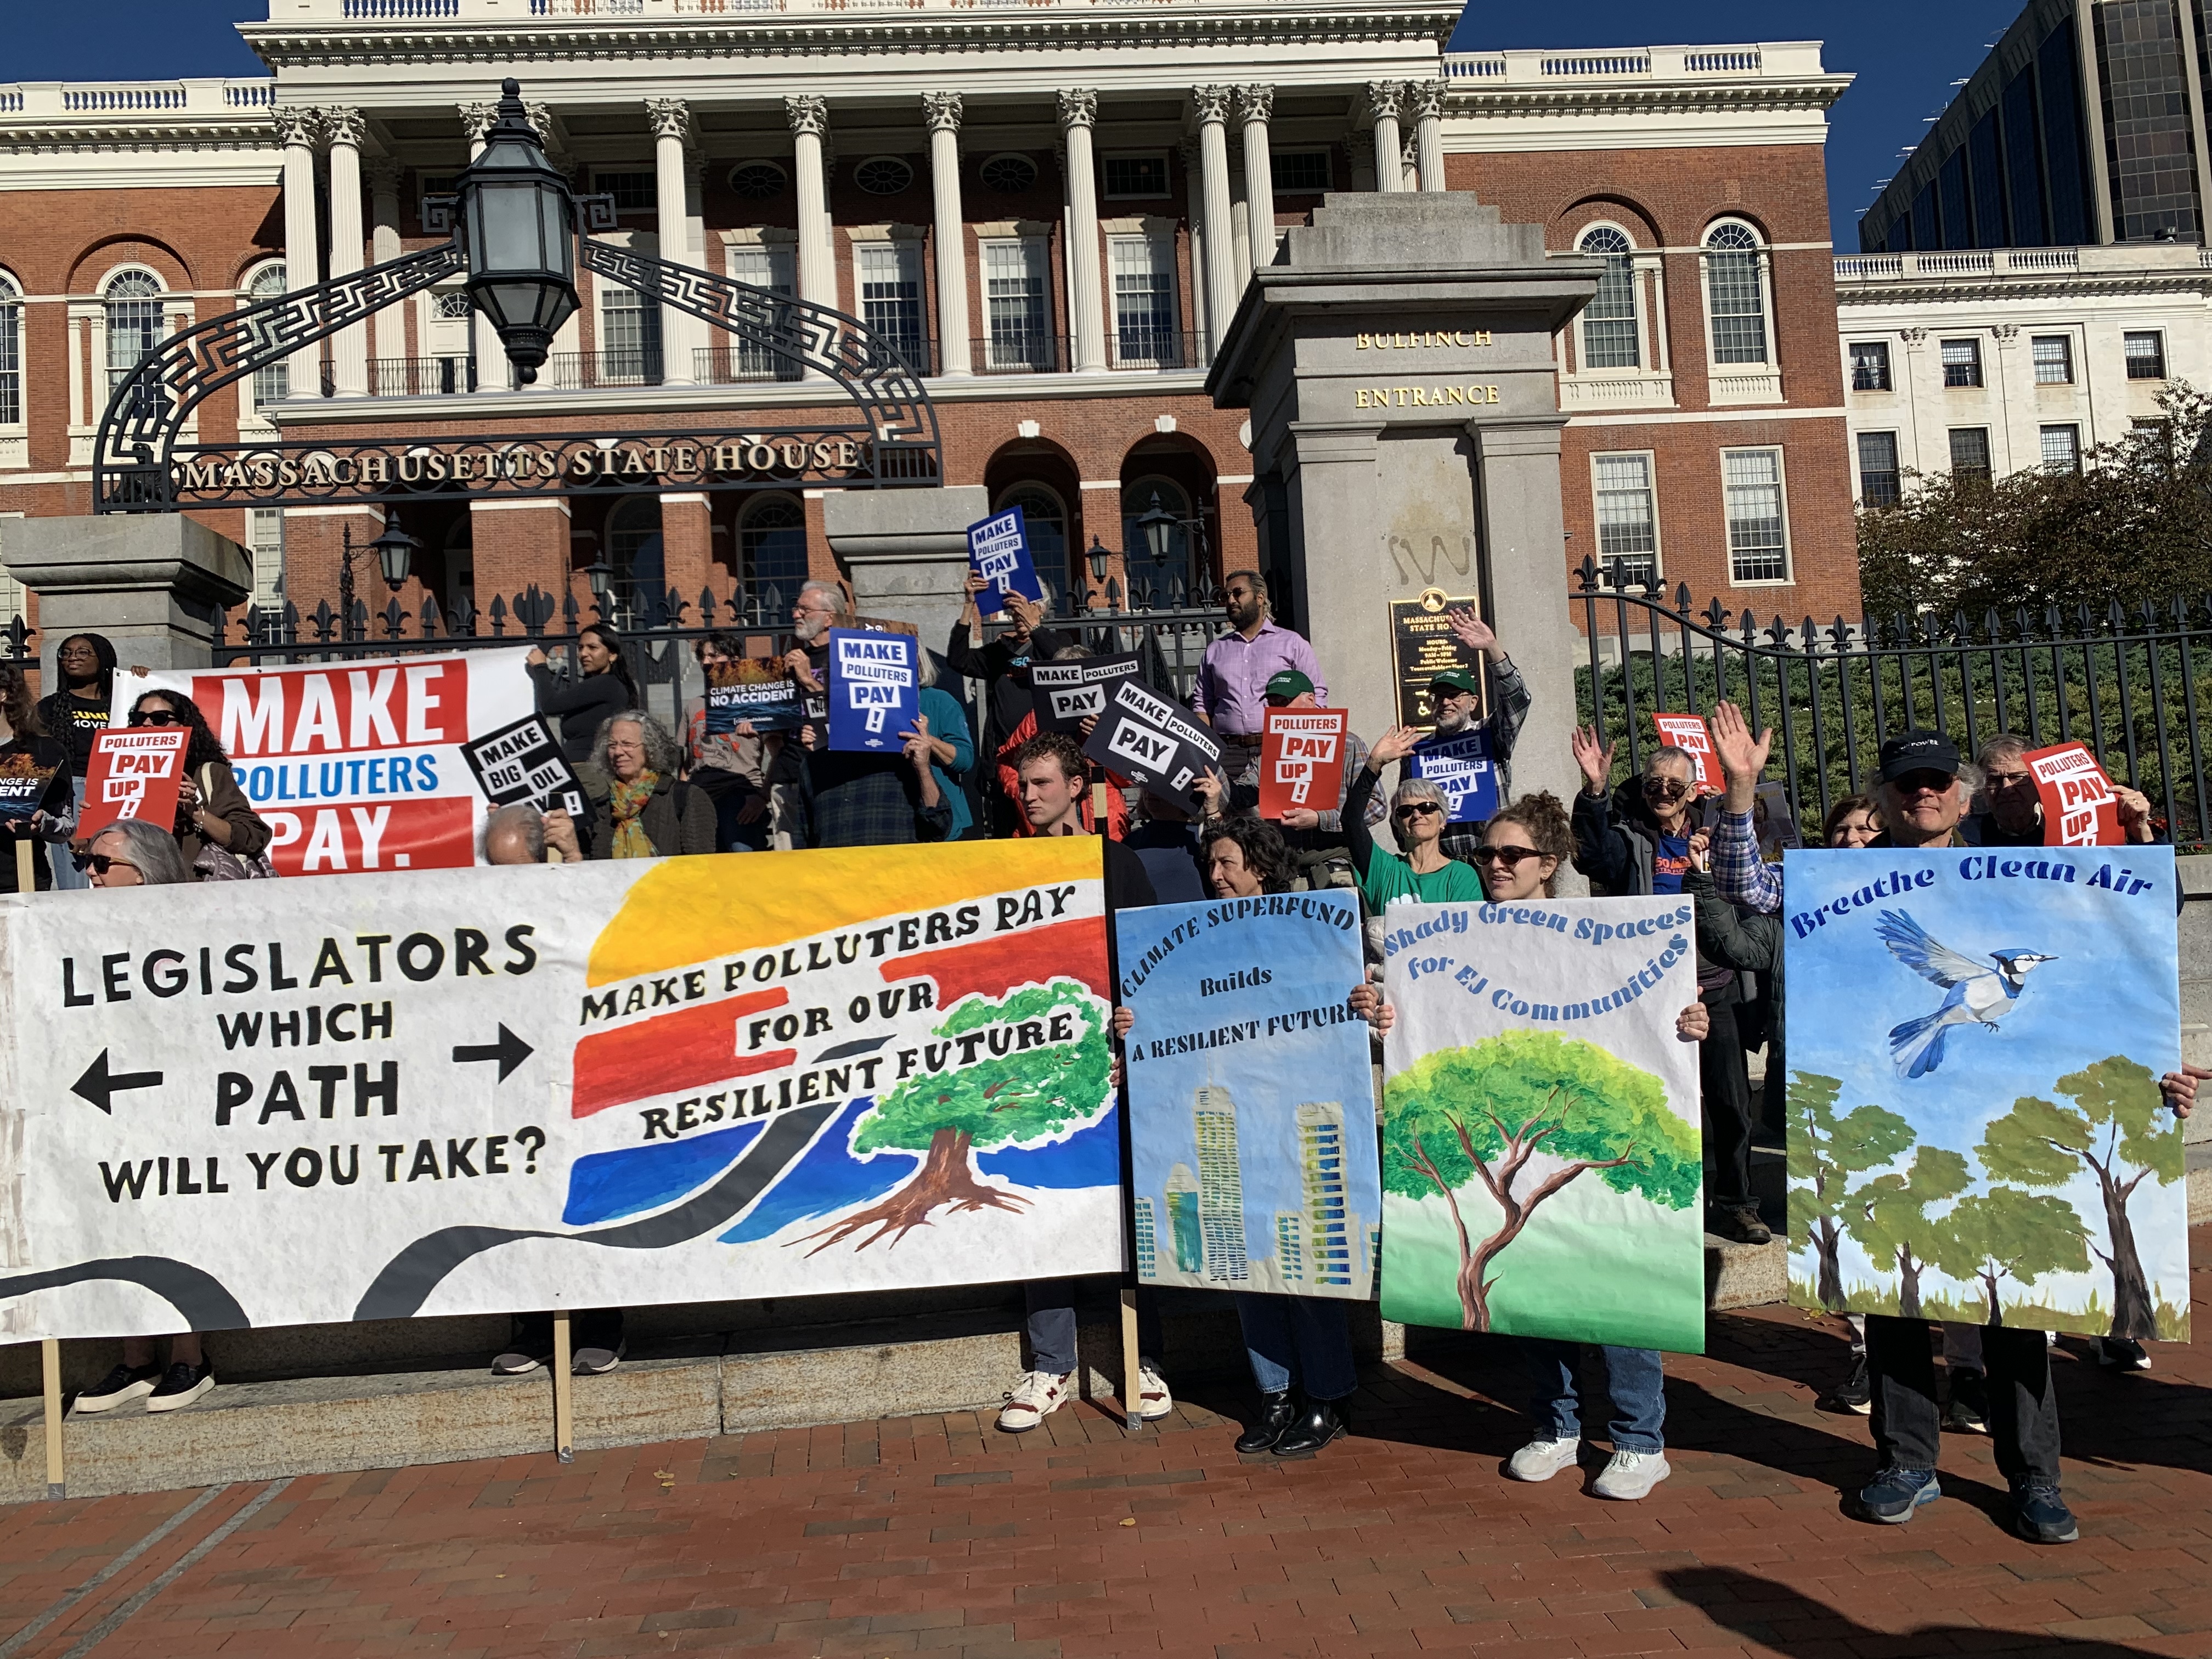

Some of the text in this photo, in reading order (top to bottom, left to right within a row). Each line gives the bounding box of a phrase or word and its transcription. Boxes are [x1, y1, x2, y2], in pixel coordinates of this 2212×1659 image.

[1356, 329, 1492, 349] BULFINCH
[1356, 385, 1500, 408] ENTRANCE
[182, 442, 859, 489] MASSACHUSETTS STATE HOUSE
[975, 518, 1013, 544] MAKE
[978, 538, 1018, 557] POLLUTERS
[984, 554, 1012, 576] PAY
[1001, 577, 1007, 590] !
[1403, 615, 1454, 624] MASSACHU
[844, 642, 901, 661] MAKE
[847, 664, 907, 681] POLLUTERS
[1036, 669, 1079, 681] MAKE
[1086, 663, 1136, 678] POLLUTERS
[710, 685, 746, 695] CLIMATE
[749, 681, 785, 691] CHANGE
[710, 689, 794, 707] NO ACCIDENT
[855, 686, 895, 704] PAY
[222, 664, 444, 755] MAKE
[1057, 691, 1097, 712] PAY
[870, 710, 880, 728] !
[1121, 688, 1217, 758] MAKE POLLUTERS
[1274, 718, 1338, 730] POLLUTERS
[105, 736, 177, 748] POLLUTERS
[479, 726, 541, 766] MAKE
[1116, 726, 1170, 763] PAY
[1287, 738, 1332, 758] PAY
[1424, 739, 1477, 762] MAKE
[1677, 734, 1705, 749] PAY
[116, 755, 168, 773] PAY
[1281, 764, 1307, 779] UP
[1427, 761, 1482, 774] POLLUTERS
[2038, 753, 2090, 777] POLLUTERS
[233, 754, 438, 801] POLLUTERS
[490, 764, 563, 791] BIG OIL
[1177, 772, 1187, 784] !
[110, 781, 139, 798] UP
[1297, 783, 1306, 799] !
[2062, 777, 2106, 805] PAY
[124, 802, 133, 816] !
[1451, 798, 1459, 808] !
[2066, 811, 2092, 837] UP
[268, 805, 410, 871] PAY.
[1790, 855, 2153, 939] Breathe Clean Air
[1384, 902, 1692, 957] Shady Green Spaces
[579, 885, 1076, 1025] MAKE POLLUTERS PAY
[1121, 896, 1354, 997] CLIMATE SUPERFUND
[63, 925, 537, 1007] LEGISLATORS
[1407, 933, 1688, 1022] for EJ Communities
[1200, 967, 1272, 996] Builds
[217, 1001, 392, 1049] WHICH
[748, 981, 933, 1049] FOR OUR
[1132, 1045, 1144, 1062] A
[1152, 1020, 1260, 1057] RESILIENT
[640, 1012, 1074, 1138] RESILIENT FUTURE
[216, 1060, 398, 1125] PATH
[98, 1126, 546, 1202] WILL YOU TAKE?
